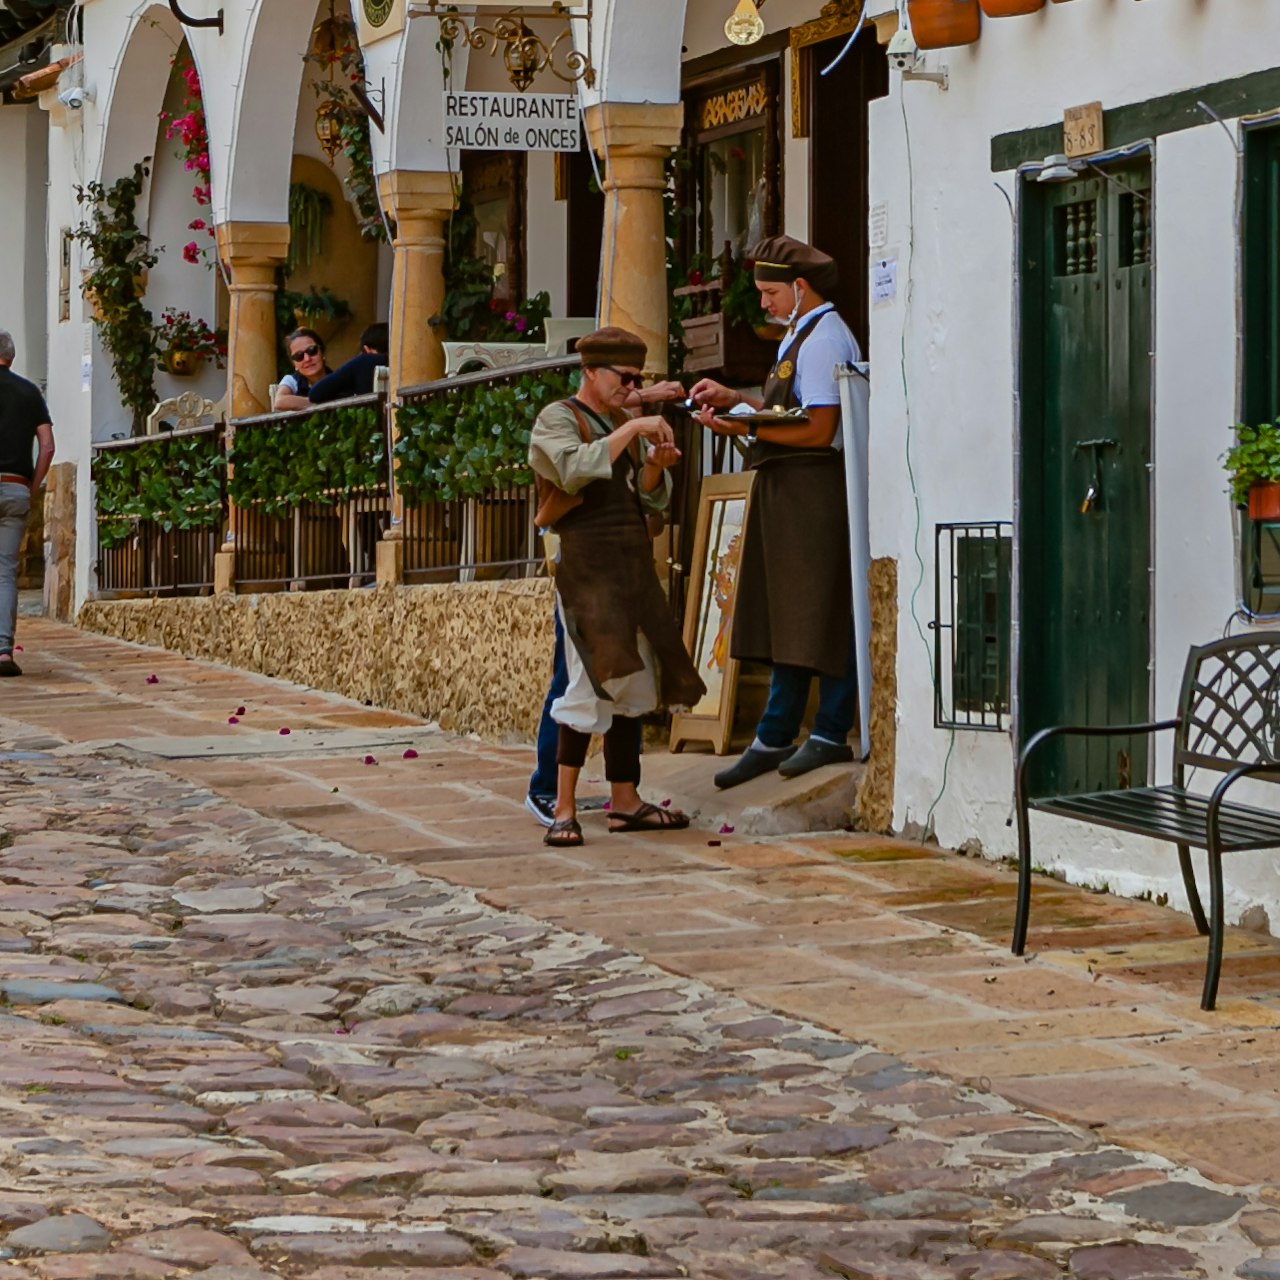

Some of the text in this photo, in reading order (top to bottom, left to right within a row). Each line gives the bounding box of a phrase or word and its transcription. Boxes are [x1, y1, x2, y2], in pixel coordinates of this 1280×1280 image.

[446, 95, 577, 119] RESTAURANTE
[446, 122, 577, 149] SALÓN de ONCES
